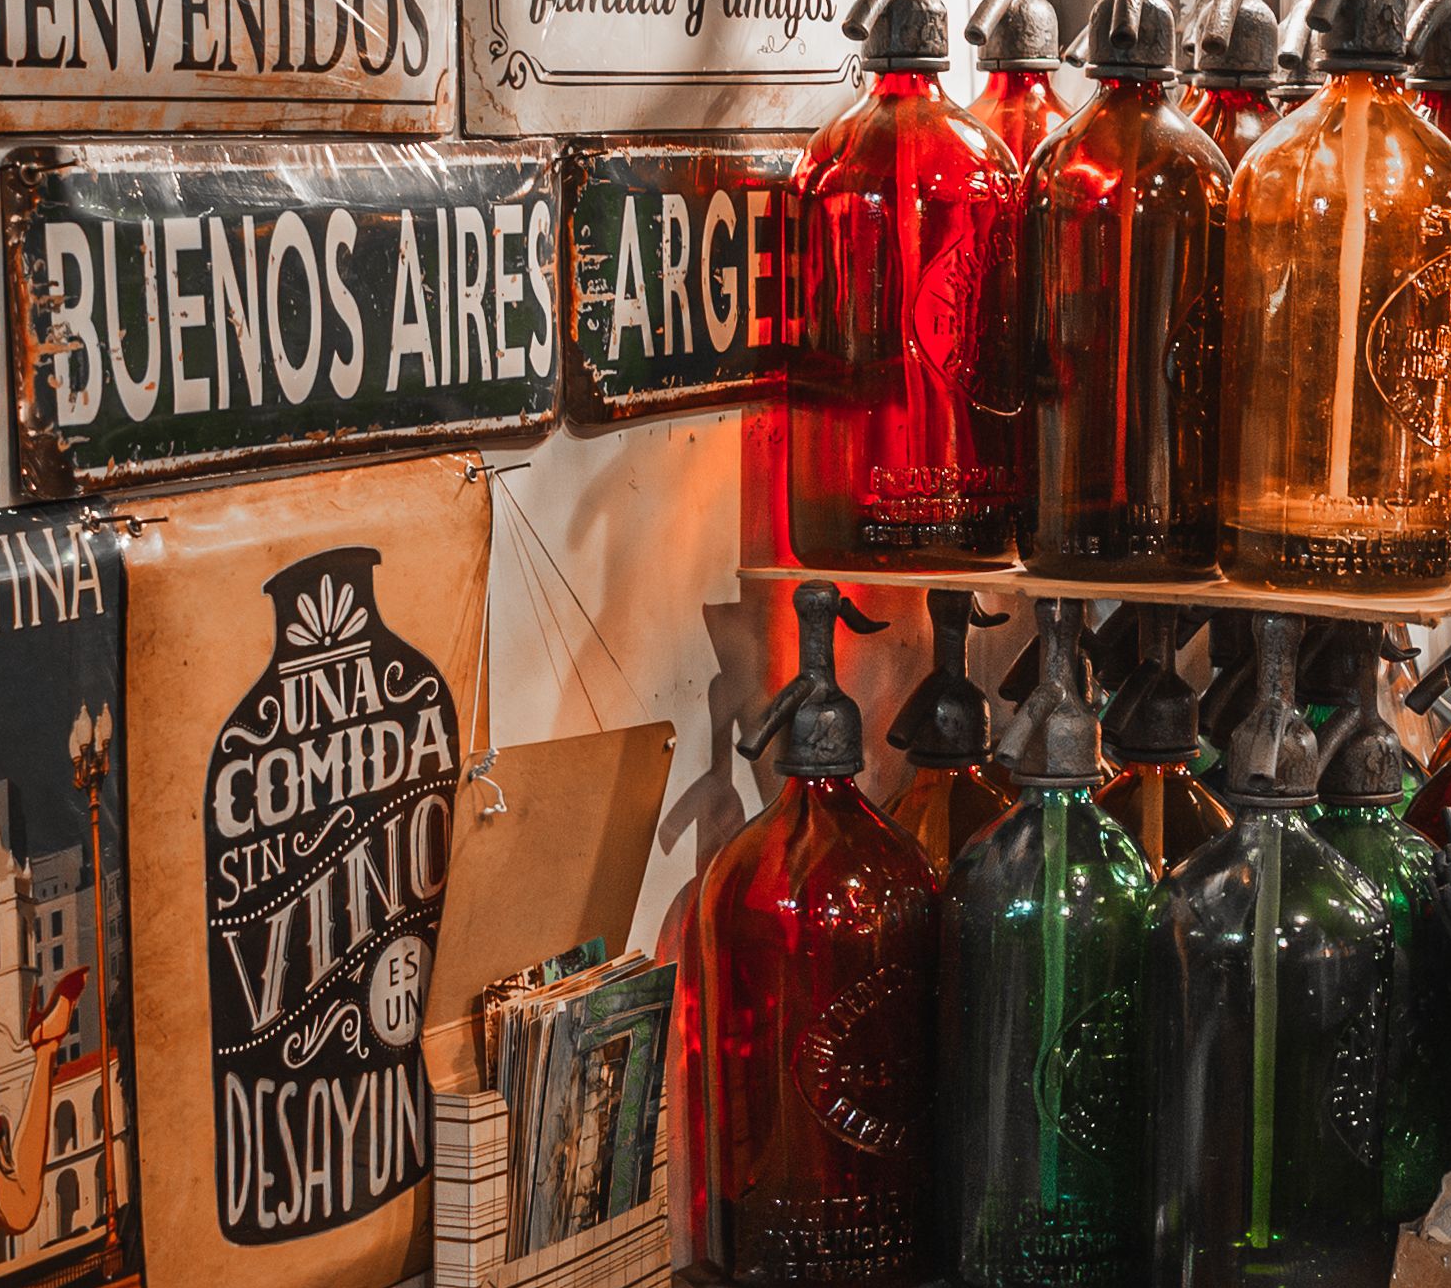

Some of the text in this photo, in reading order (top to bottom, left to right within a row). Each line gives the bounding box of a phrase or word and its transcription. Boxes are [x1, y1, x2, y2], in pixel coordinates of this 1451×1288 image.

[45, 198, 553, 427] BUENOS AIRES
[281, 657, 384, 734] UNA
[213, 706, 455, 837] COMIDA
[219, 832, 287, 911] SIN
[221, 793, 453, 1034] VINO
[387, 948, 419, 989] ES
[384, 985, 424, 1032] UN
